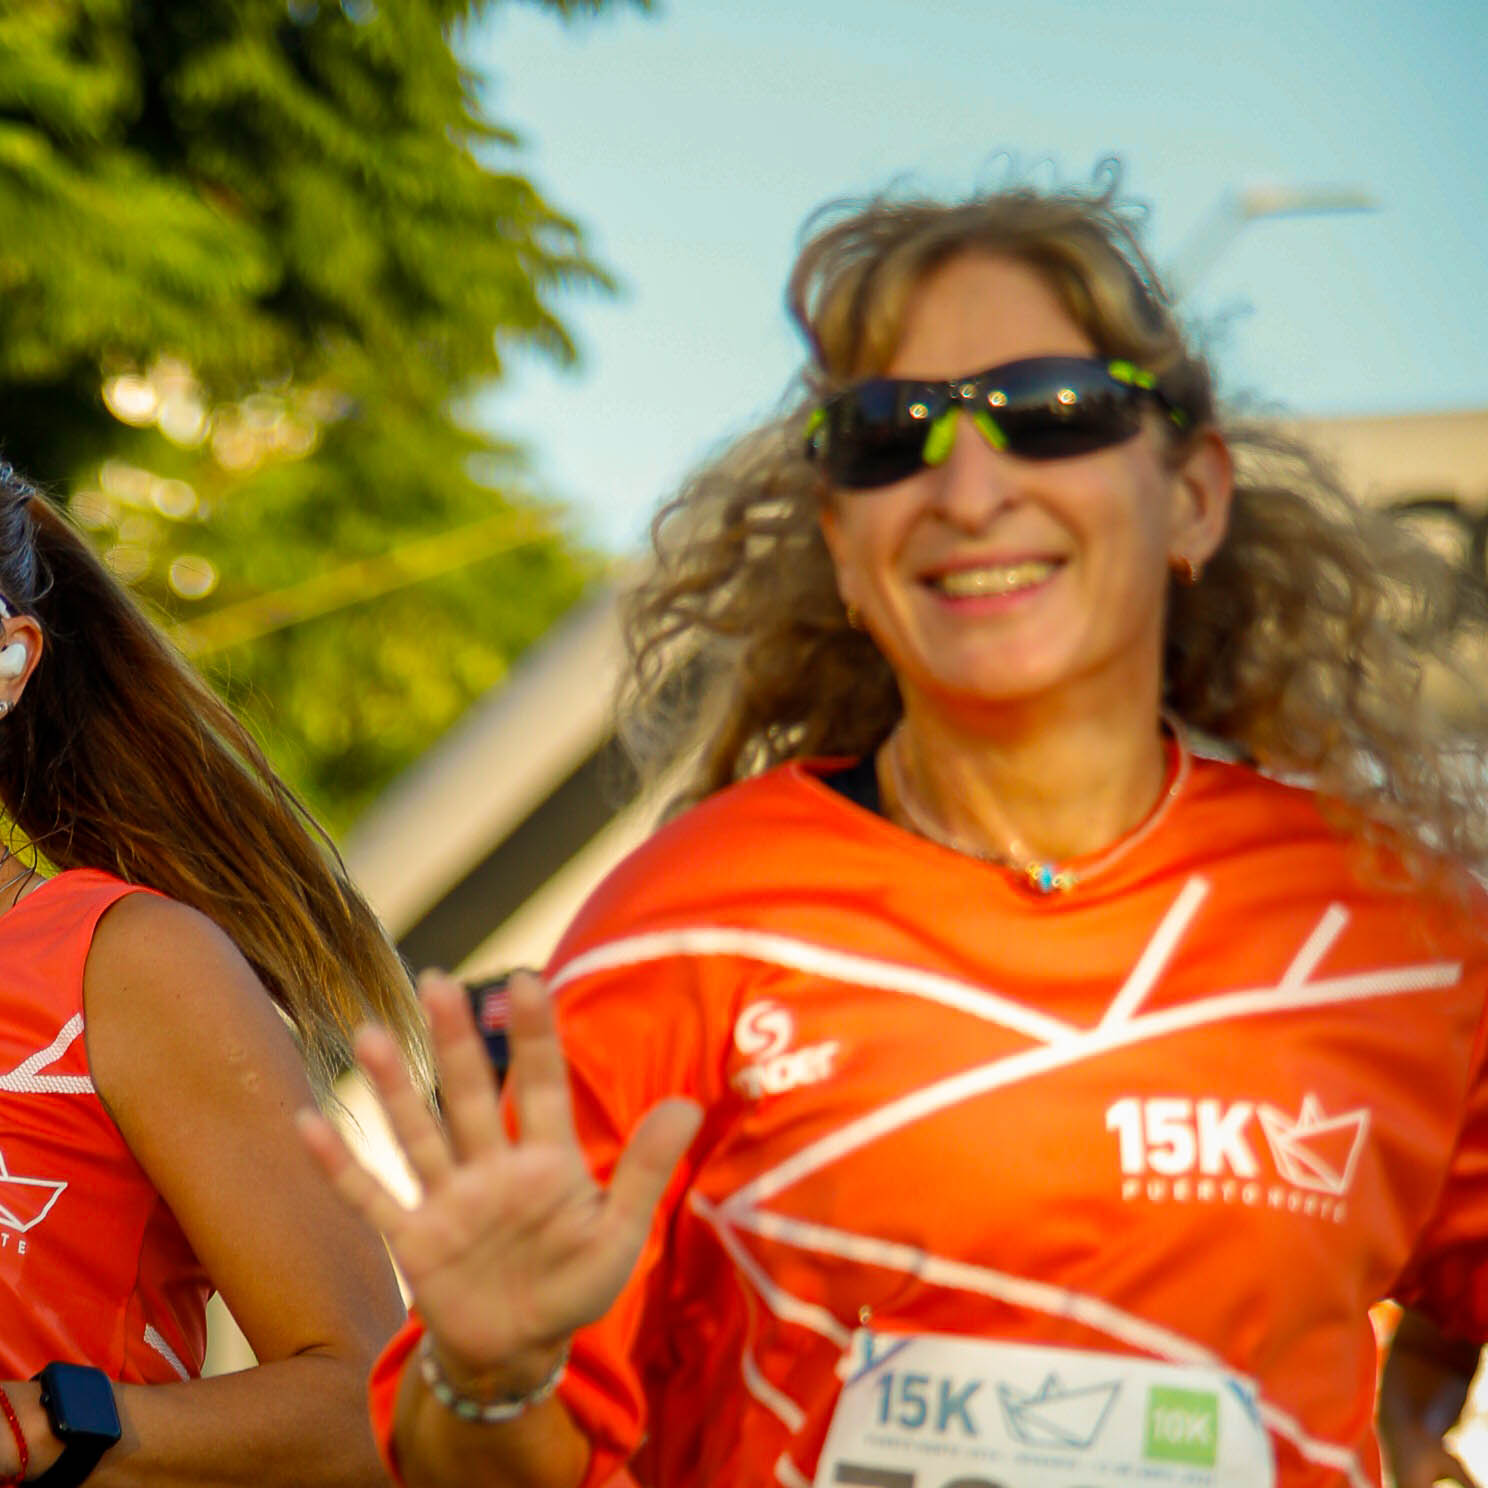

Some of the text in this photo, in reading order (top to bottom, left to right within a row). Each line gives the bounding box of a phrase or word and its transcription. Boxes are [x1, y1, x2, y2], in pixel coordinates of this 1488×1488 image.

[1105, 1096, 1260, 1178] 15K
[1122, 1178, 1349, 1223] PUERTO NORTE
[875, 1372, 981, 1437] 15K
[1151, 1405, 1212, 1444] 10K
